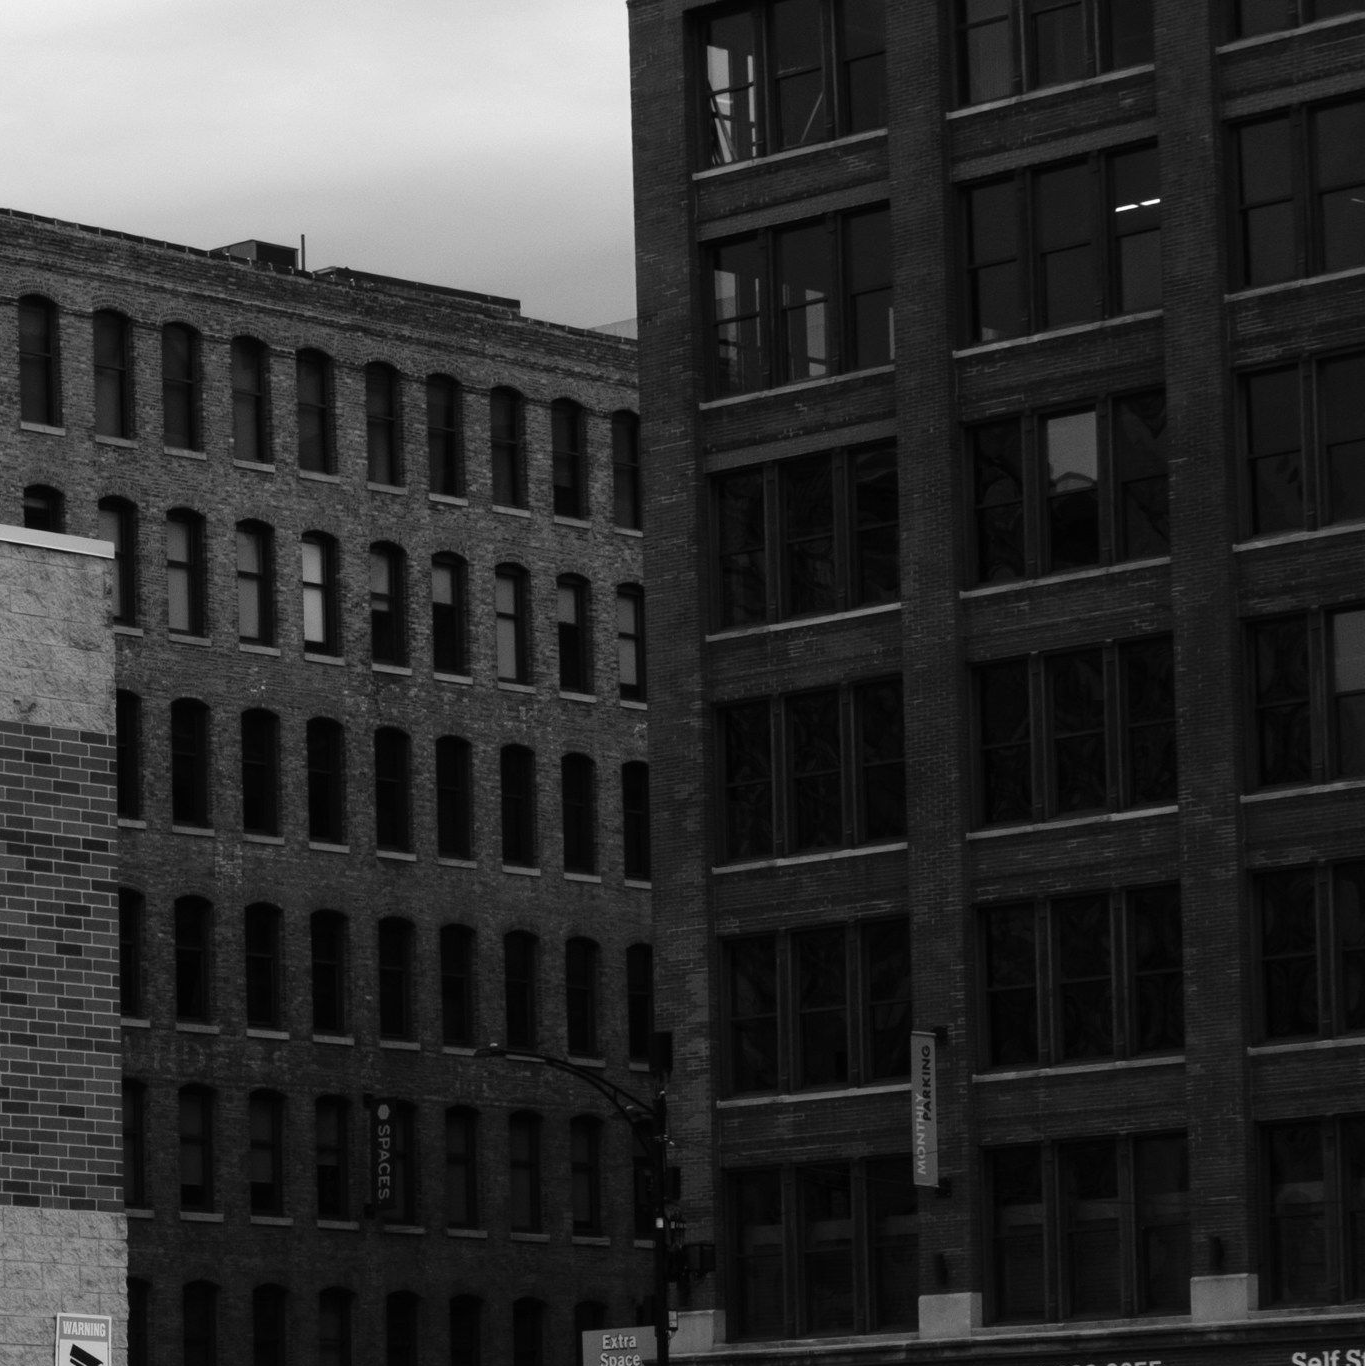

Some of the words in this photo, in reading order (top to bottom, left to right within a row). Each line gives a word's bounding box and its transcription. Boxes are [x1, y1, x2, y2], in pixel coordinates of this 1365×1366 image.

[922, 1044, 932, 1121] PARKING
[916, 1093, 926, 1174] MONTHLY
[62, 1320, 106, 1338] WARNING
[602, 1334, 636, 1349] Extra
